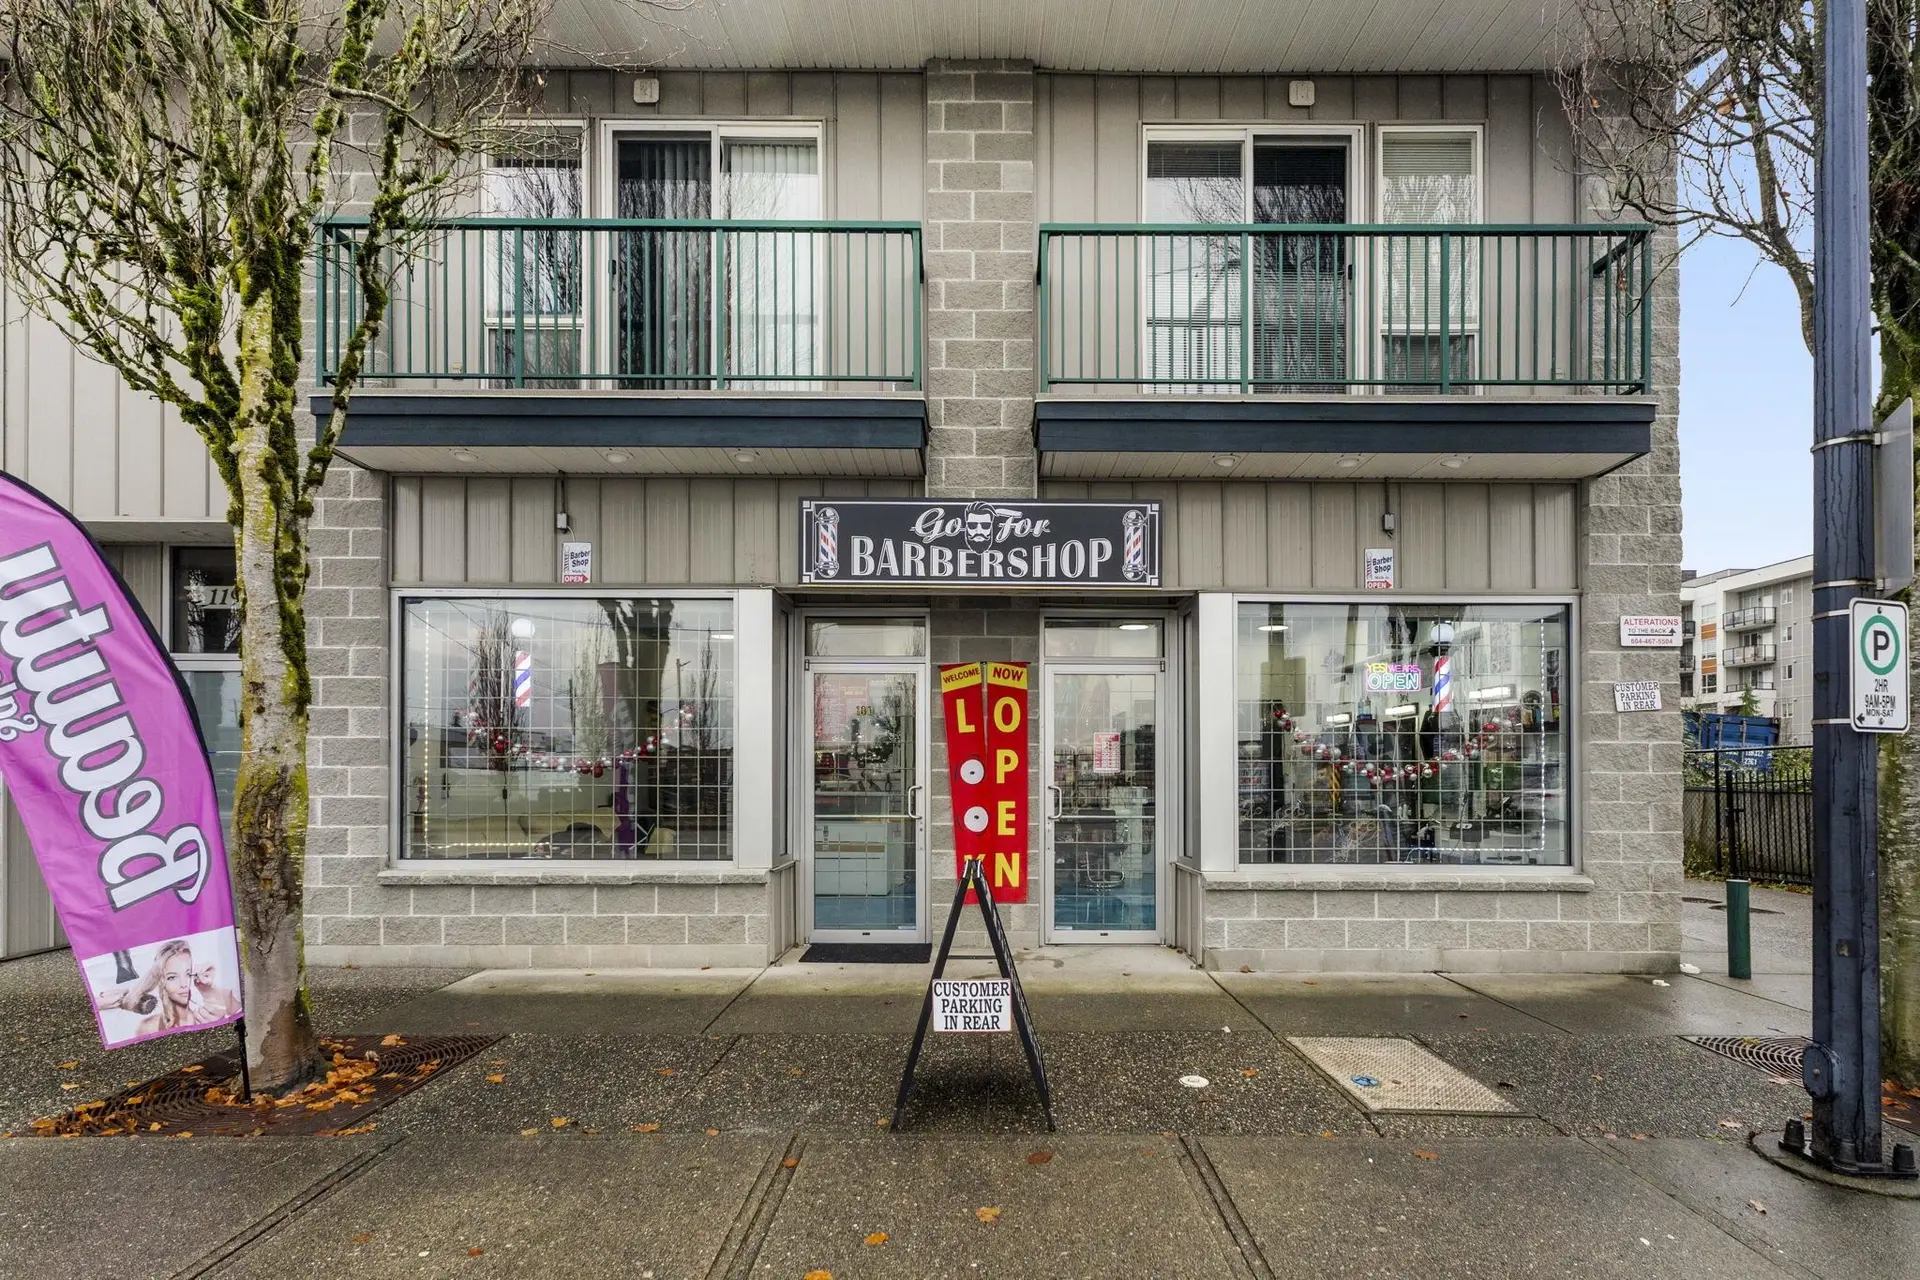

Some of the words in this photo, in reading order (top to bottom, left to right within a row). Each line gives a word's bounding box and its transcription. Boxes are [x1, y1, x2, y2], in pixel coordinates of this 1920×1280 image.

[909, 507, 967, 544] Go
[993, 507, 1051, 544] For
[570, 550, 591, 560] Barber
[850, 535, 1113, 578] BARBERSHOP
[1372, 556, 1393, 566] Barber
[571, 558, 589, 568] Shop
[1374, 564, 1392, 574] Shop
[564, 575, 584, 583] OPEN
[1623, 618, 1679, 626] ALTERATIONS
[1873, 630, 1890, 661] P
[942, 667, 980, 684] WELCOME
[992, 667, 1024, 682] NOW
[1388, 664, 1402, 673] WE
[1403, 664, 1418, 673] ARE
[1368, 673, 1419, 690] OPEN
[1614, 682, 1660, 692] CUSTOMER
[1874, 678, 1889, 693] 2HR
[1620, 691, 1656, 701] PARKING
[1864, 694, 1896, 709] 9AM-5PM
[1622, 701, 1631, 711] IN
[1634, 700, 1656, 710] REAR
[1865, 708, 1895, 718] MON-SAT
[993, 696, 1021, 888] OPEN
[934, 982, 1010, 997] CUSTOMER
[941, 999, 1002, 1014] PARKING
[944, 1015, 958, 1030] IN
[963, 1015, 1001, 1030] REAR
